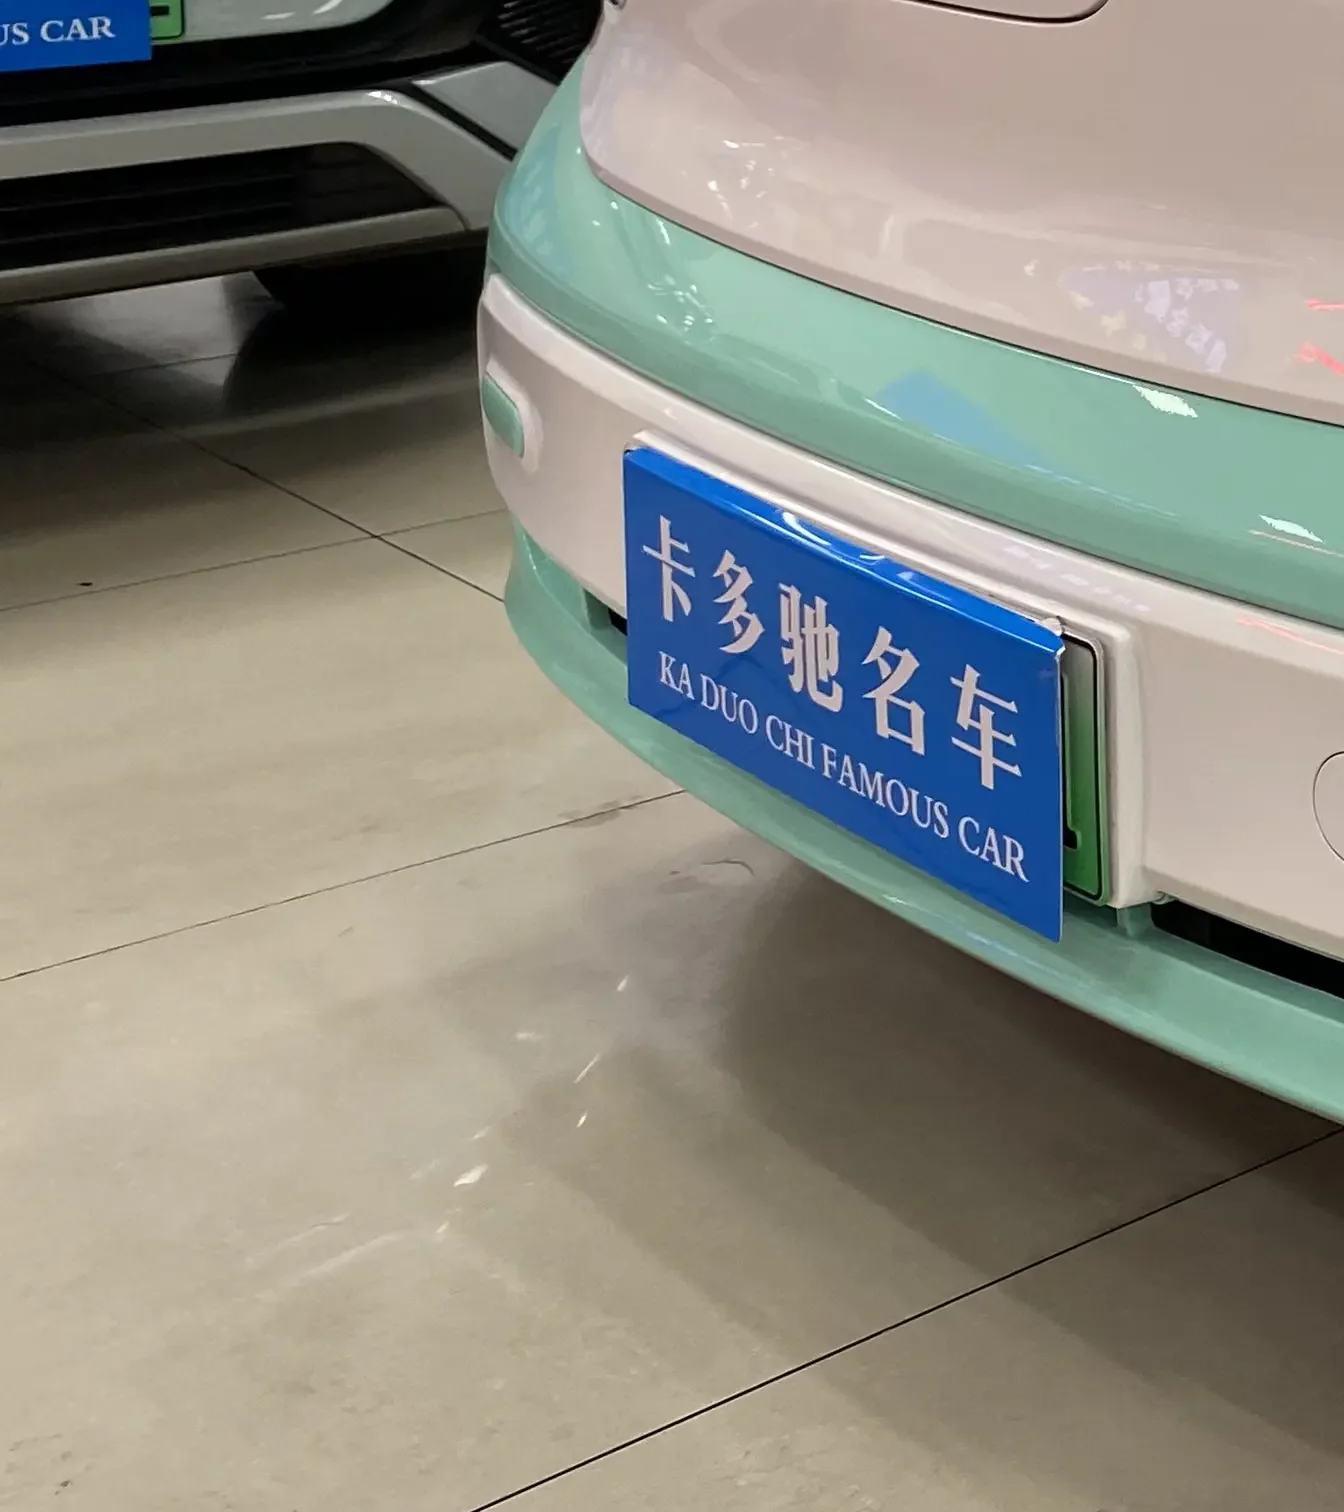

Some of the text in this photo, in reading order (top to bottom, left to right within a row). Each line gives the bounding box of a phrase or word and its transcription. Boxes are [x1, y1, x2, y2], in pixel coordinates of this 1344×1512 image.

[40, 16, 116, 43] CAR
[641, 514, 1023, 791] 卡多驰名车
[658, 651, 1031, 884] KA DUO CHI FAMOUS CAR
